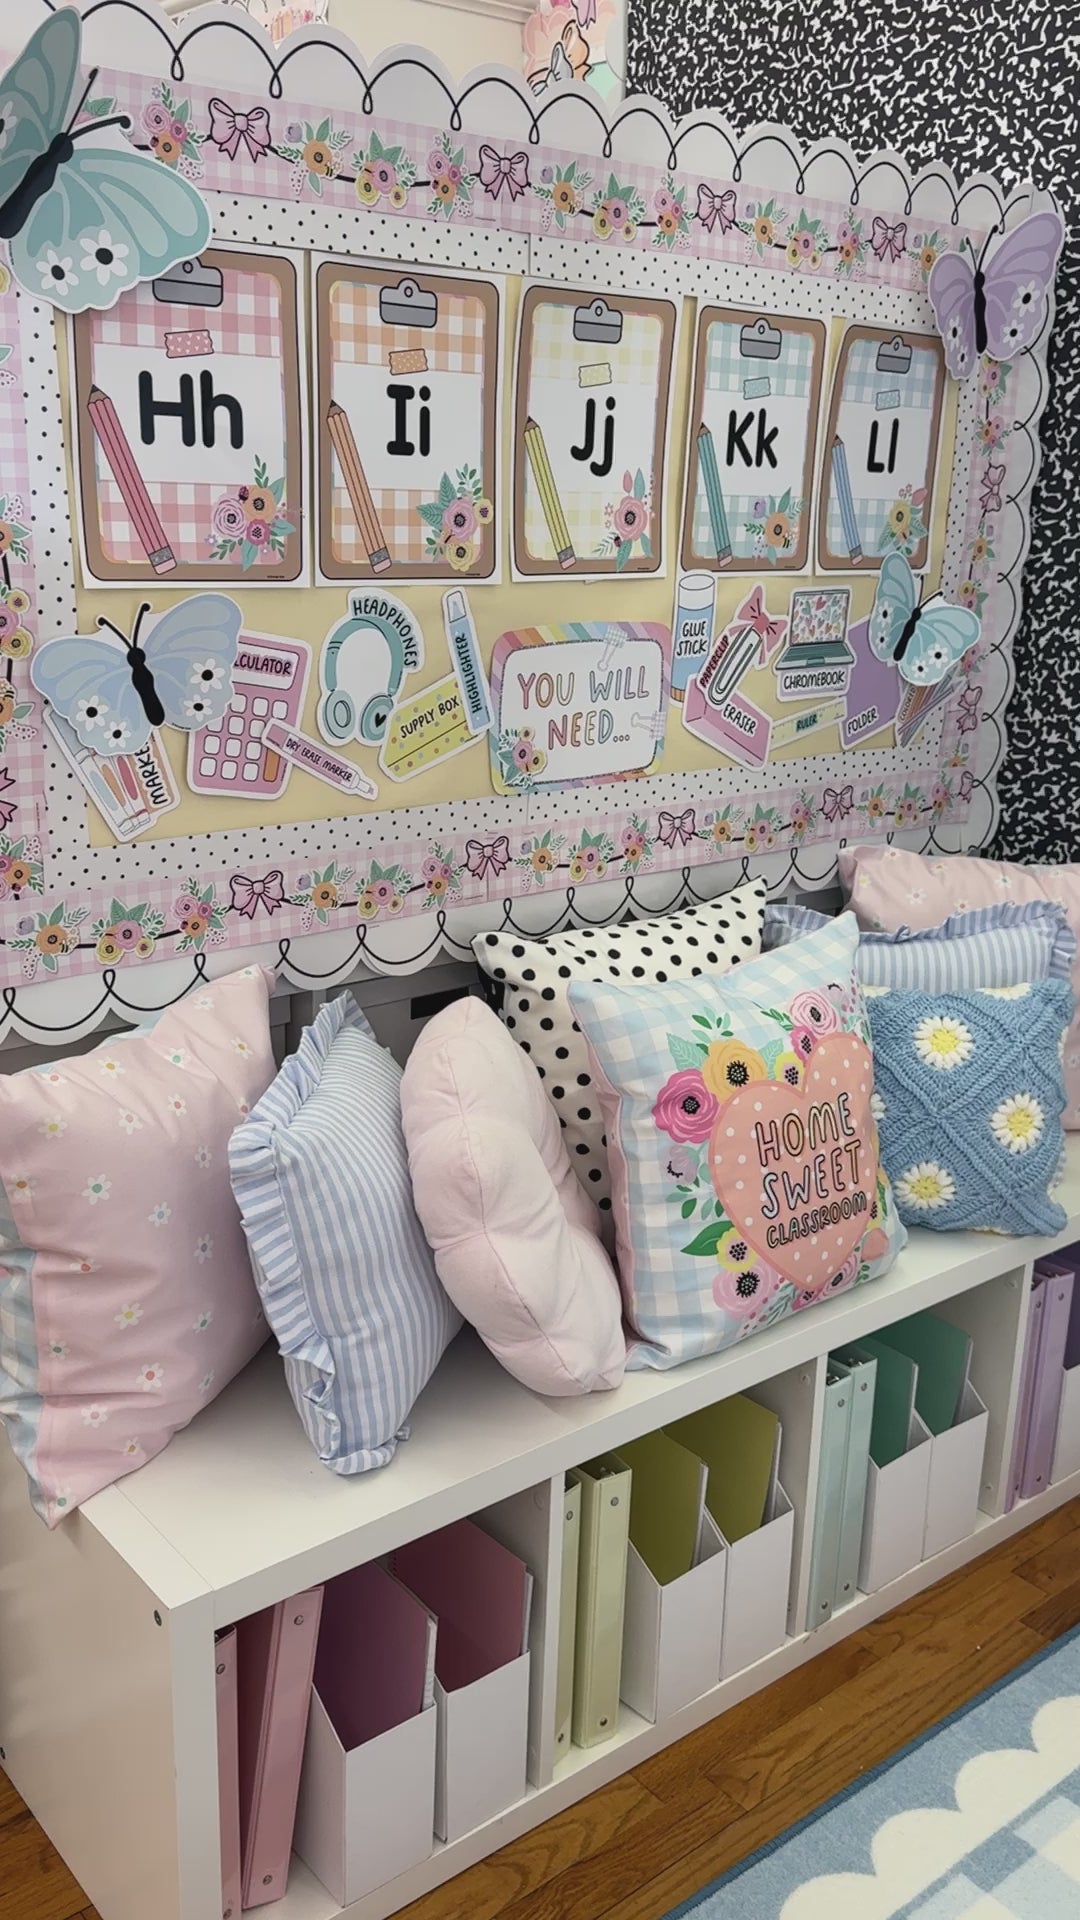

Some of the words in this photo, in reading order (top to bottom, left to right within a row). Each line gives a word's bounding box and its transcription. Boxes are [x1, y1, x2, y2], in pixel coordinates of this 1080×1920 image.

[138, 370, 244, 449] Hh
[386, 383, 431, 457] Ii
[571, 396, 617, 477] Jj
[726, 408, 779, 469] Kk
[867, 418, 900, 474] Ll
[352, 598, 418, 668] HEADPHONES
[676, 639, 708, 656] STICK
[682, 621, 707, 637] GLUE
[234, 654, 292, 675] LCULATOR
[455, 632, 482, 714] HIGHLIGHTER
[517, 672, 575, 710] YOU
[589, 665, 650, 703] WILL
[699, 635, 729, 688] PAPERCLIP
[783, 670, 846, 690] CHROMEBOOK
[400, 708, 435, 739] SUPPLY
[438, 695, 460, 716] BOX
[548, 709, 630, 750] NEED...
[723, 703, 757, 734] ERASER
[796, 713, 817, 732] RULER
[847, 707, 878, 734] FOLDER
[134, 741, 168, 805] MARKE
[285, 738, 300, 752] DRY
[301, 747, 322, 765] ERASE
[322, 760, 353, 782] MARKER
[755, 1091, 855, 1167] HOME
[761, 1139, 862, 1219] SWEET
[766, 1190, 868, 1249] CLASSROOM
